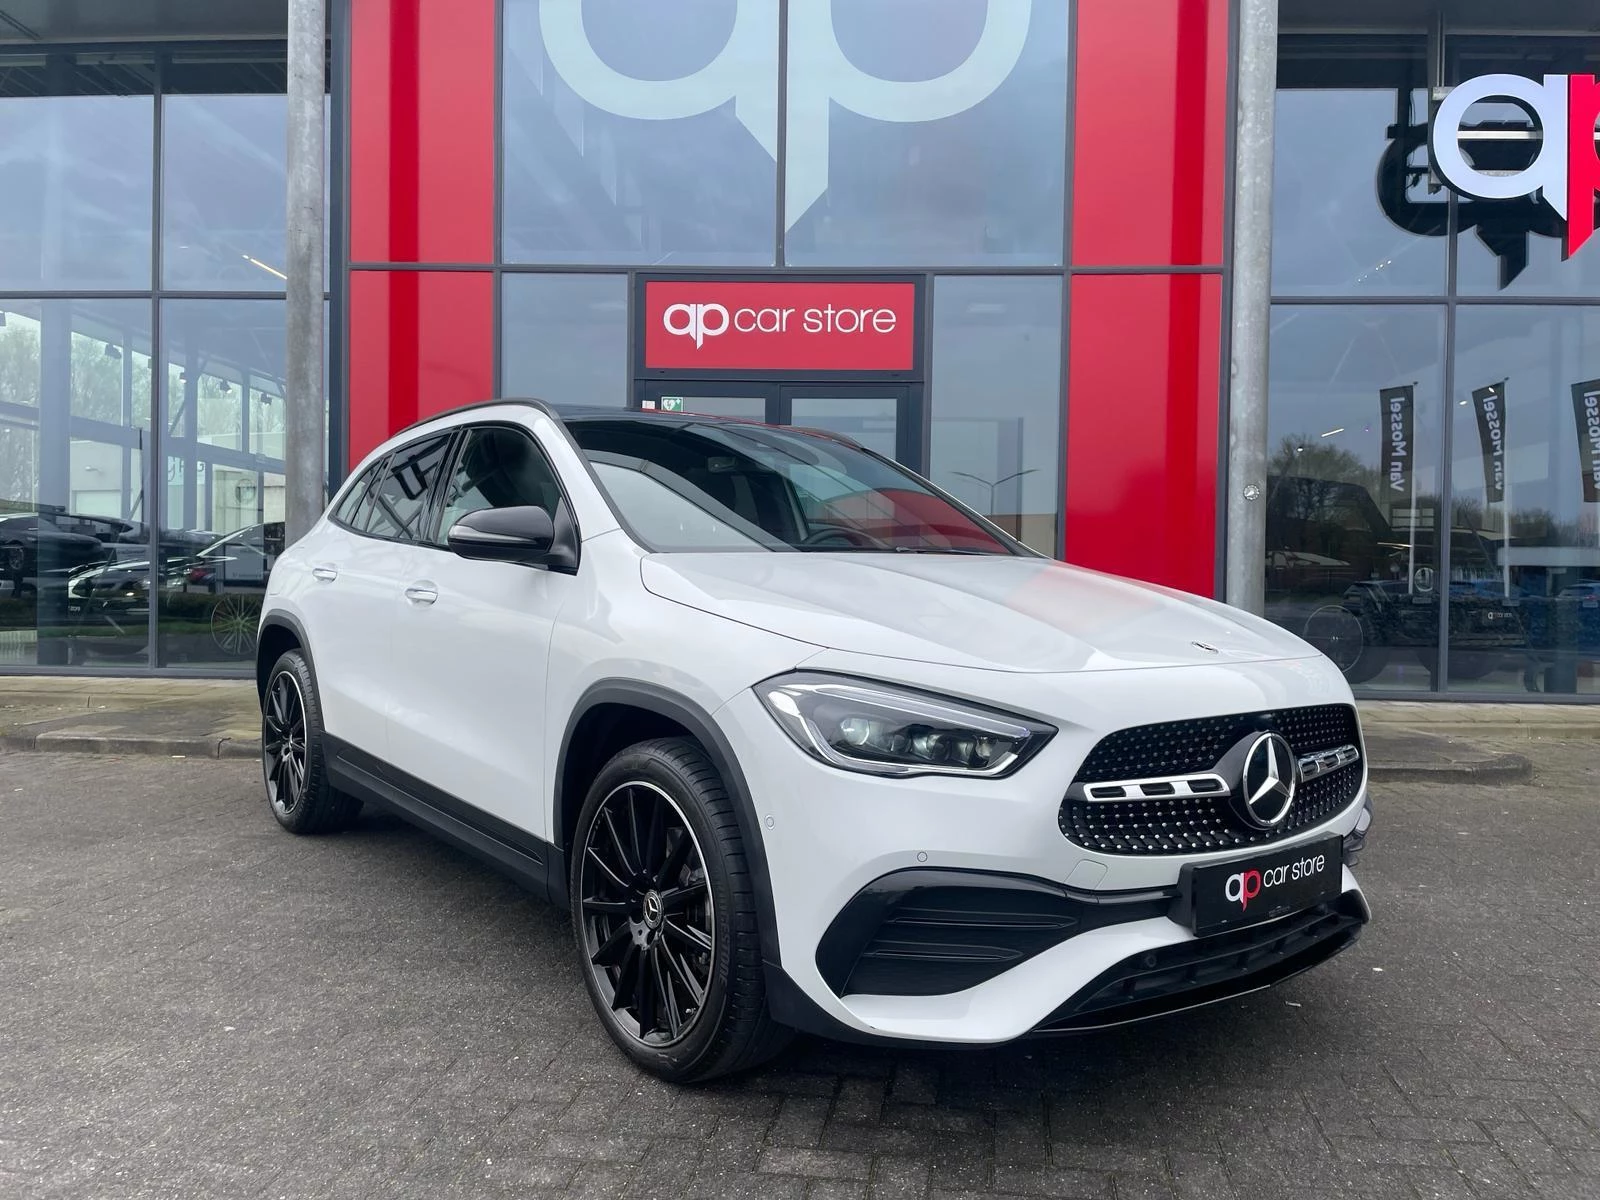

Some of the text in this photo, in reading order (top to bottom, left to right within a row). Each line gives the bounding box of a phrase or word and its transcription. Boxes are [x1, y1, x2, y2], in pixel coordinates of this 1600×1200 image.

[734, 308, 796, 333] car
[803, 303, 897, 333] store
[1263, 864, 1290, 888] car
[1291, 854, 1325, 881] store
